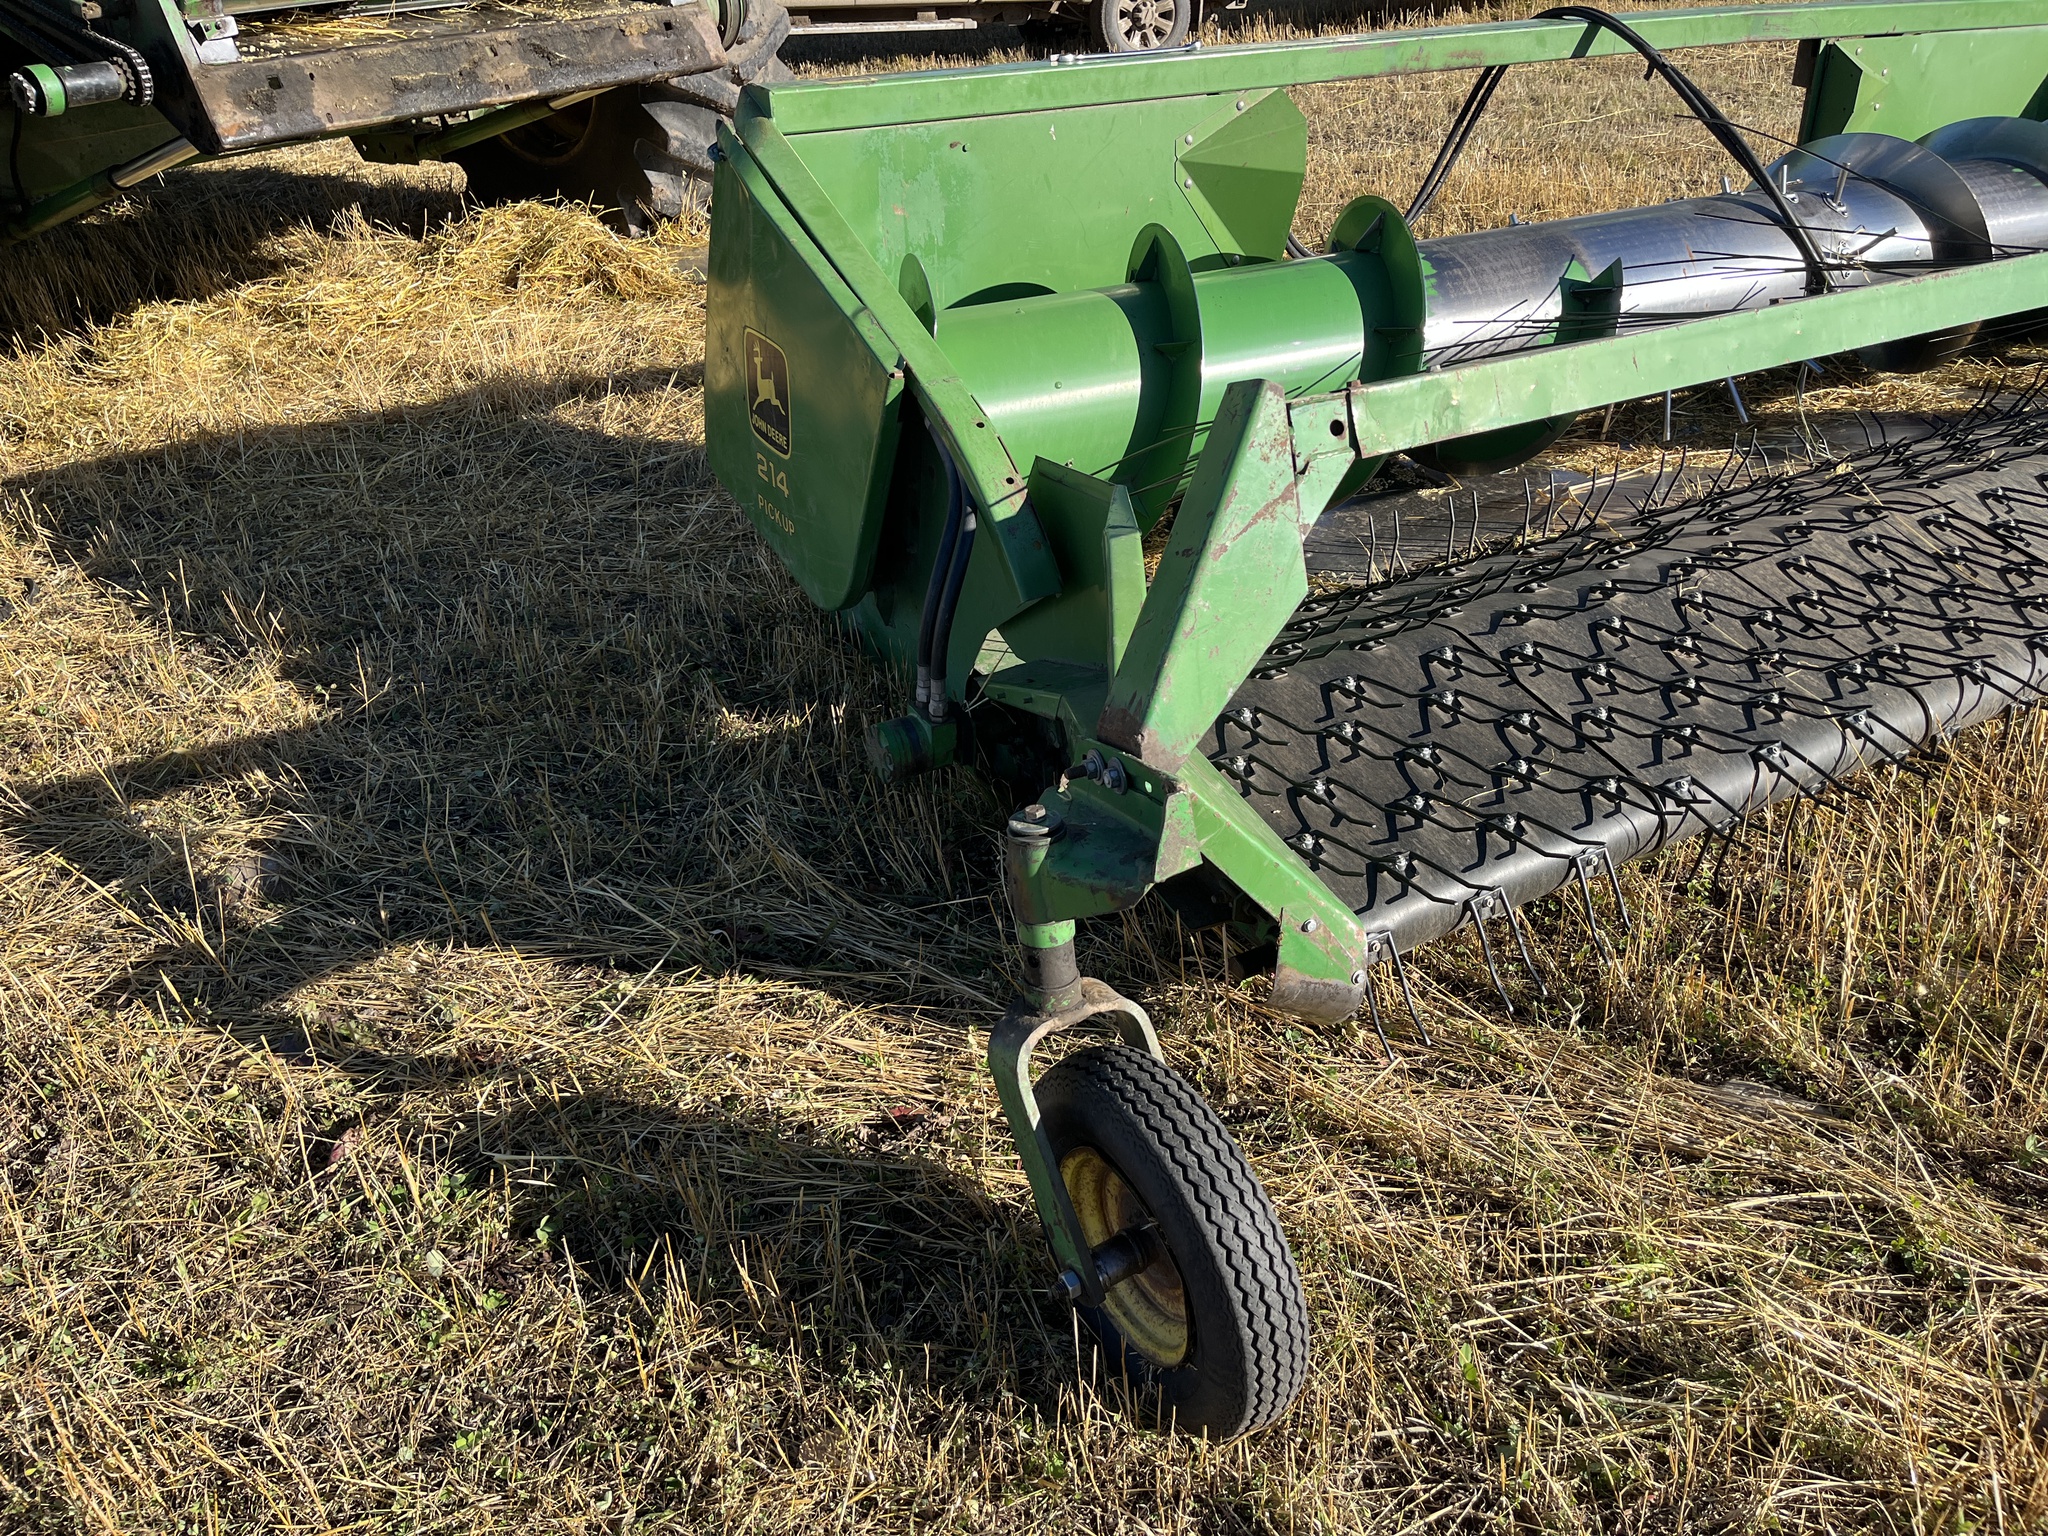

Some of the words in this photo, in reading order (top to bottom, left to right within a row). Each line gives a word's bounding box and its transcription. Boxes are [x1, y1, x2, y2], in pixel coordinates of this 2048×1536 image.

[752, 413, 767, 434] JOHN
[767, 424, 788, 450] DEERE
[756, 452, 789, 498] 214
[758, 494, 795, 535] PICKUP
